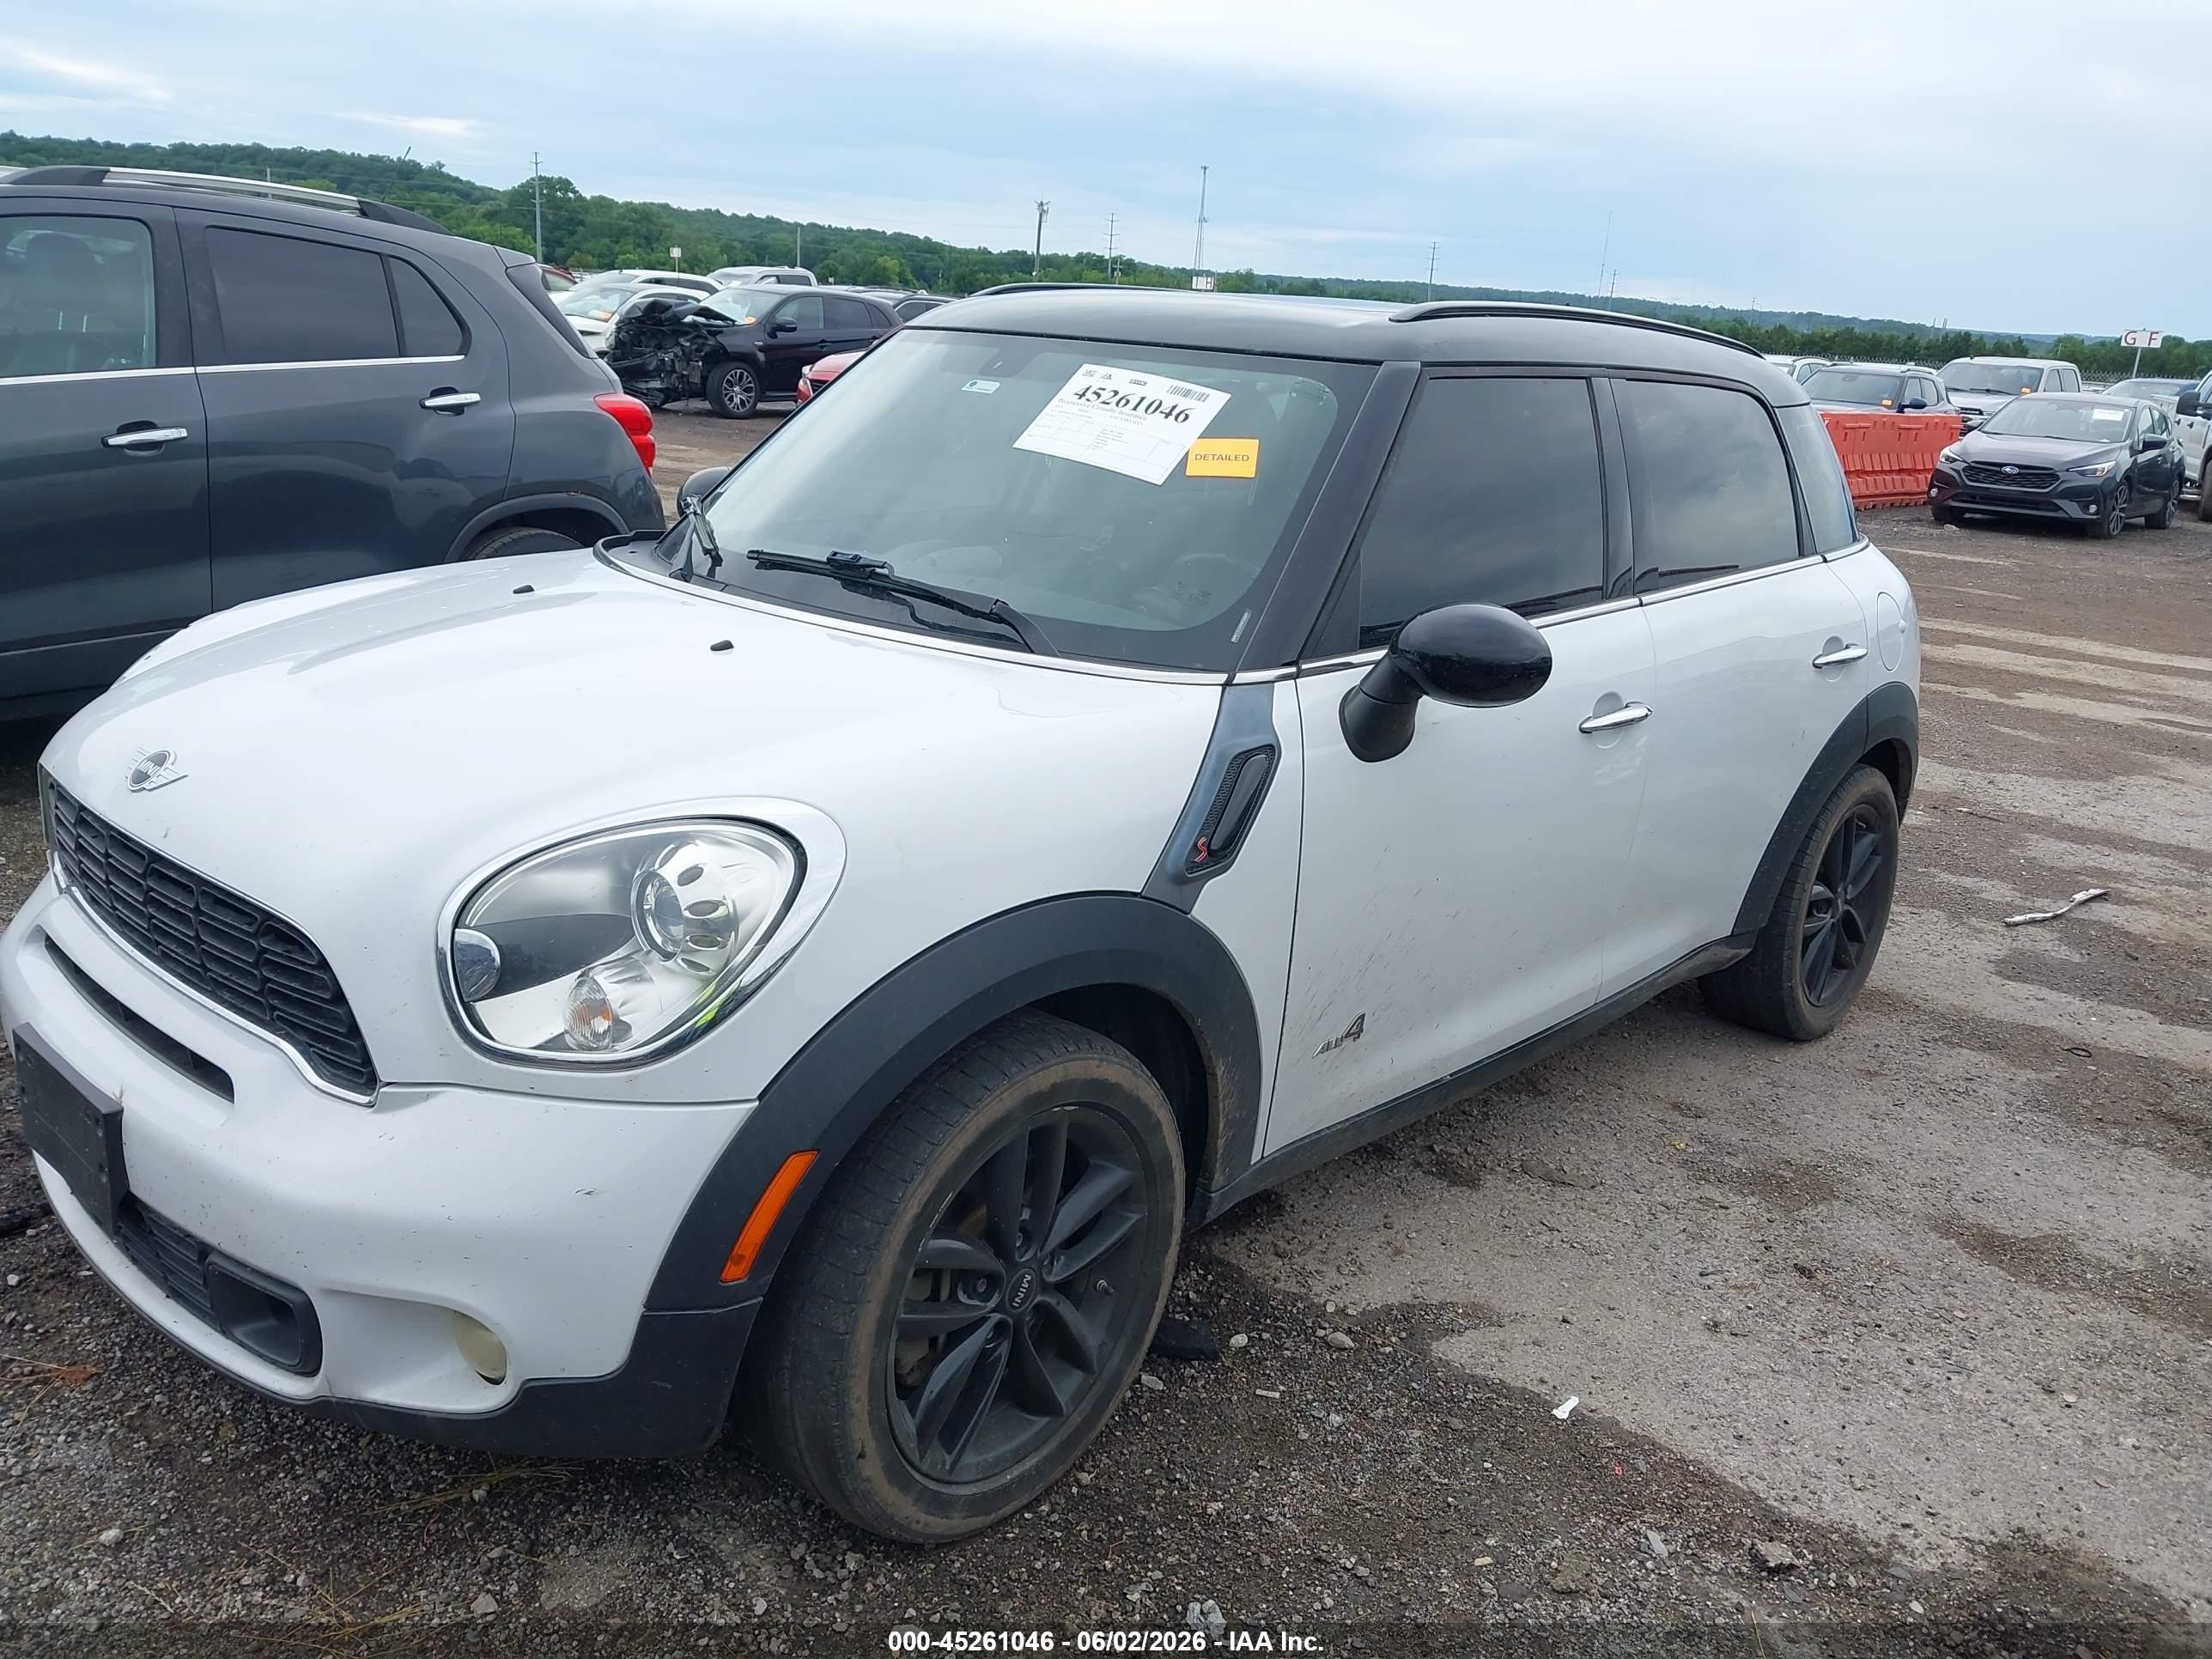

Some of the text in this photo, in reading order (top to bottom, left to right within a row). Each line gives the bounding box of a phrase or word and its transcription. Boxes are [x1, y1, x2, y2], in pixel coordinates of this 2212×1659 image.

[2124, 331, 2159, 346] G F
[1073, 385, 1196, 423] 45261046
[1194, 453, 1249, 462] DETAILED
[1012, 1273, 1031, 1307] MINI
